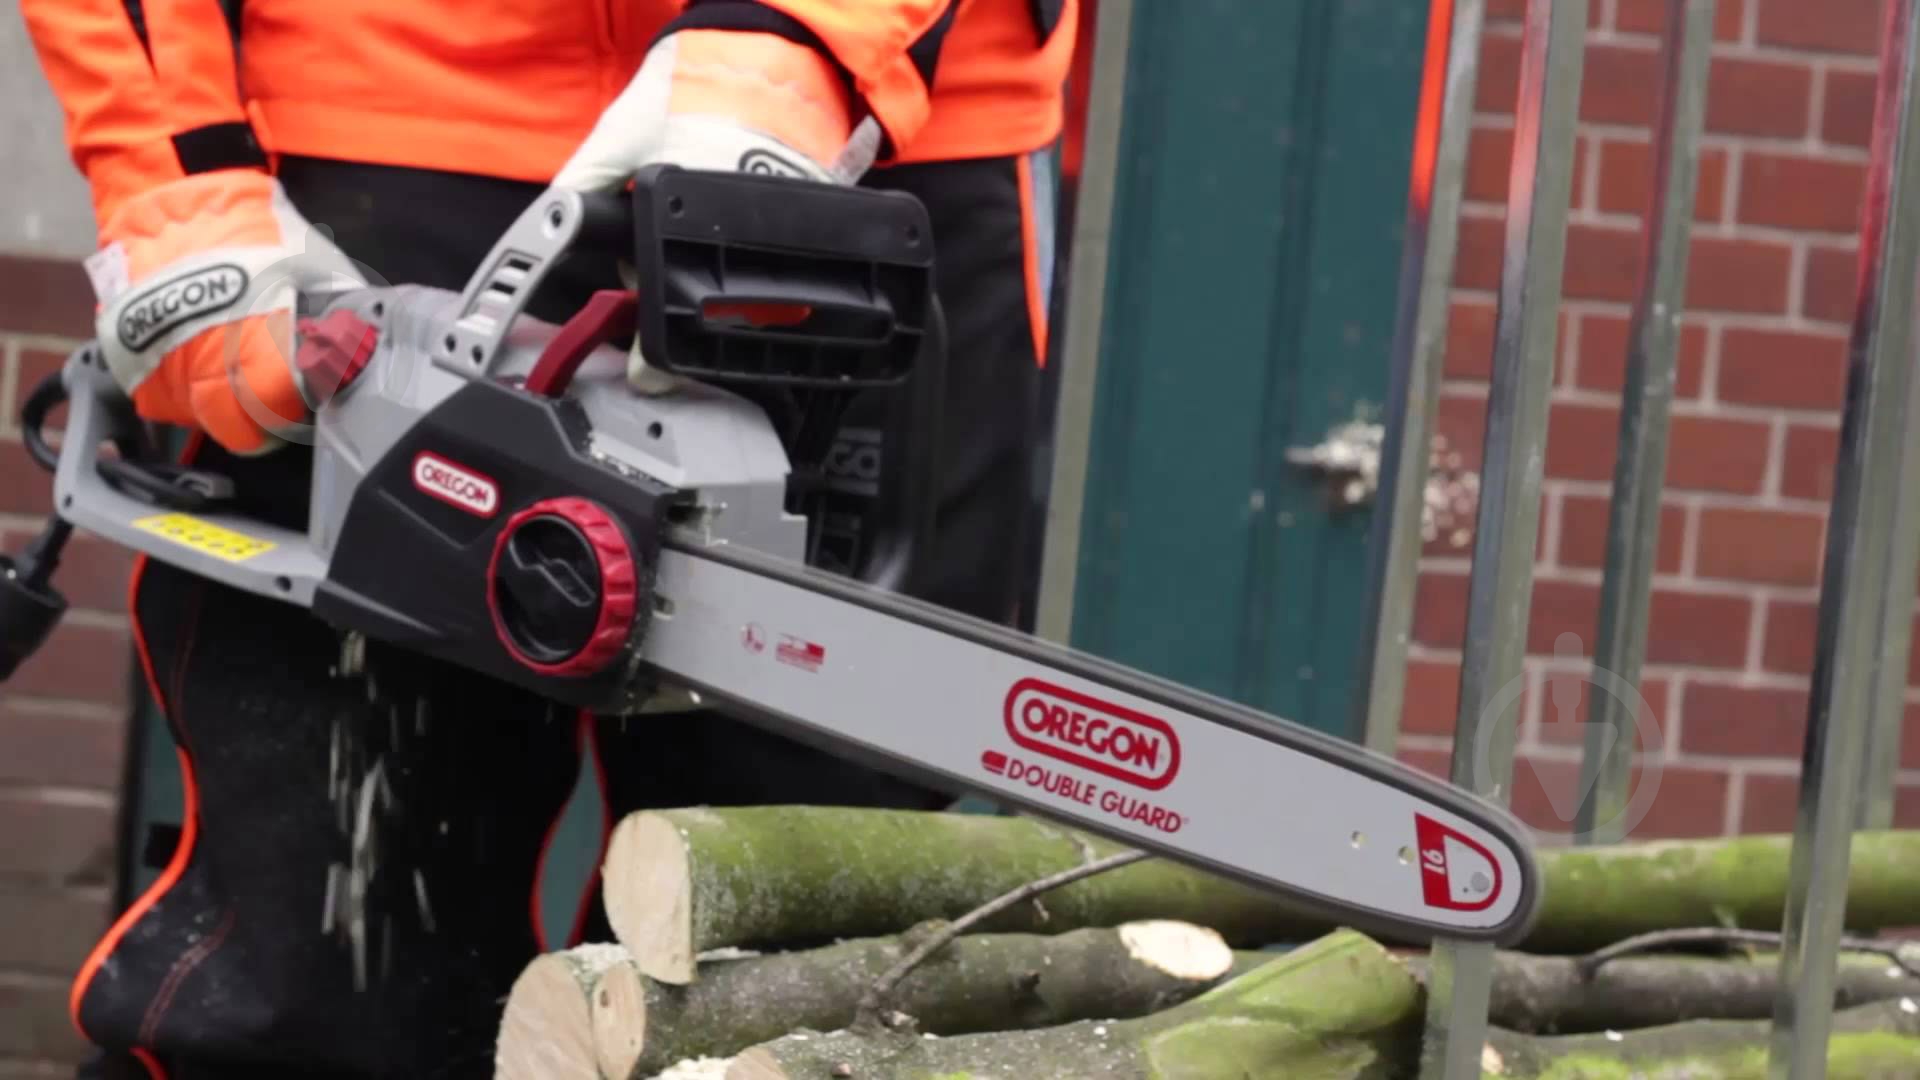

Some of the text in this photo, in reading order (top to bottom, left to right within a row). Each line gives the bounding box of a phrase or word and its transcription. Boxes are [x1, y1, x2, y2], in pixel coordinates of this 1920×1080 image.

[124, 274, 228, 342] OREGON
[422, 463, 488, 506] OREGON
[1022, 698, 1160, 771] OREGON
[1007, 759, 1182, 833] DOUBLE GUARD
